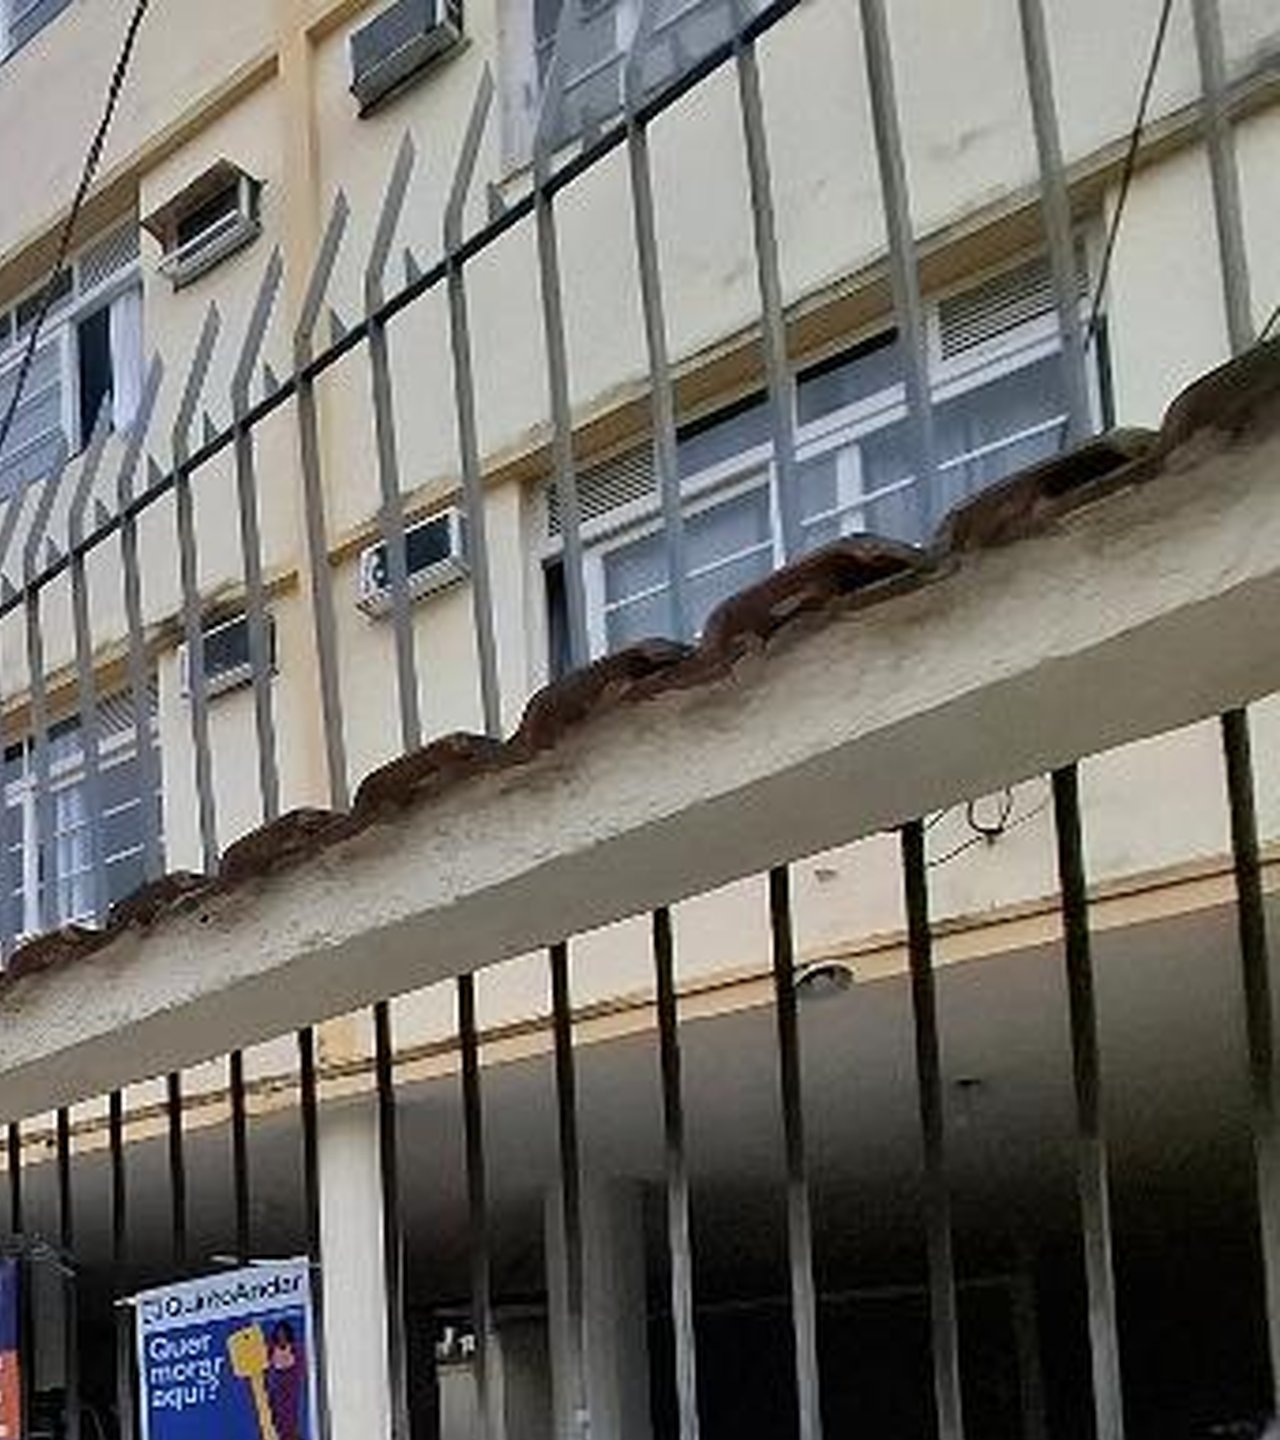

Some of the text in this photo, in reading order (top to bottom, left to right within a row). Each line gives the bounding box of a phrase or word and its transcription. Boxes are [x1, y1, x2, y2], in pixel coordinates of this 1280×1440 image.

[149, 1334, 213, 1361] Quer
[150, 1356, 225, 1385] morar
[151, 1375, 221, 1412] aqui?
